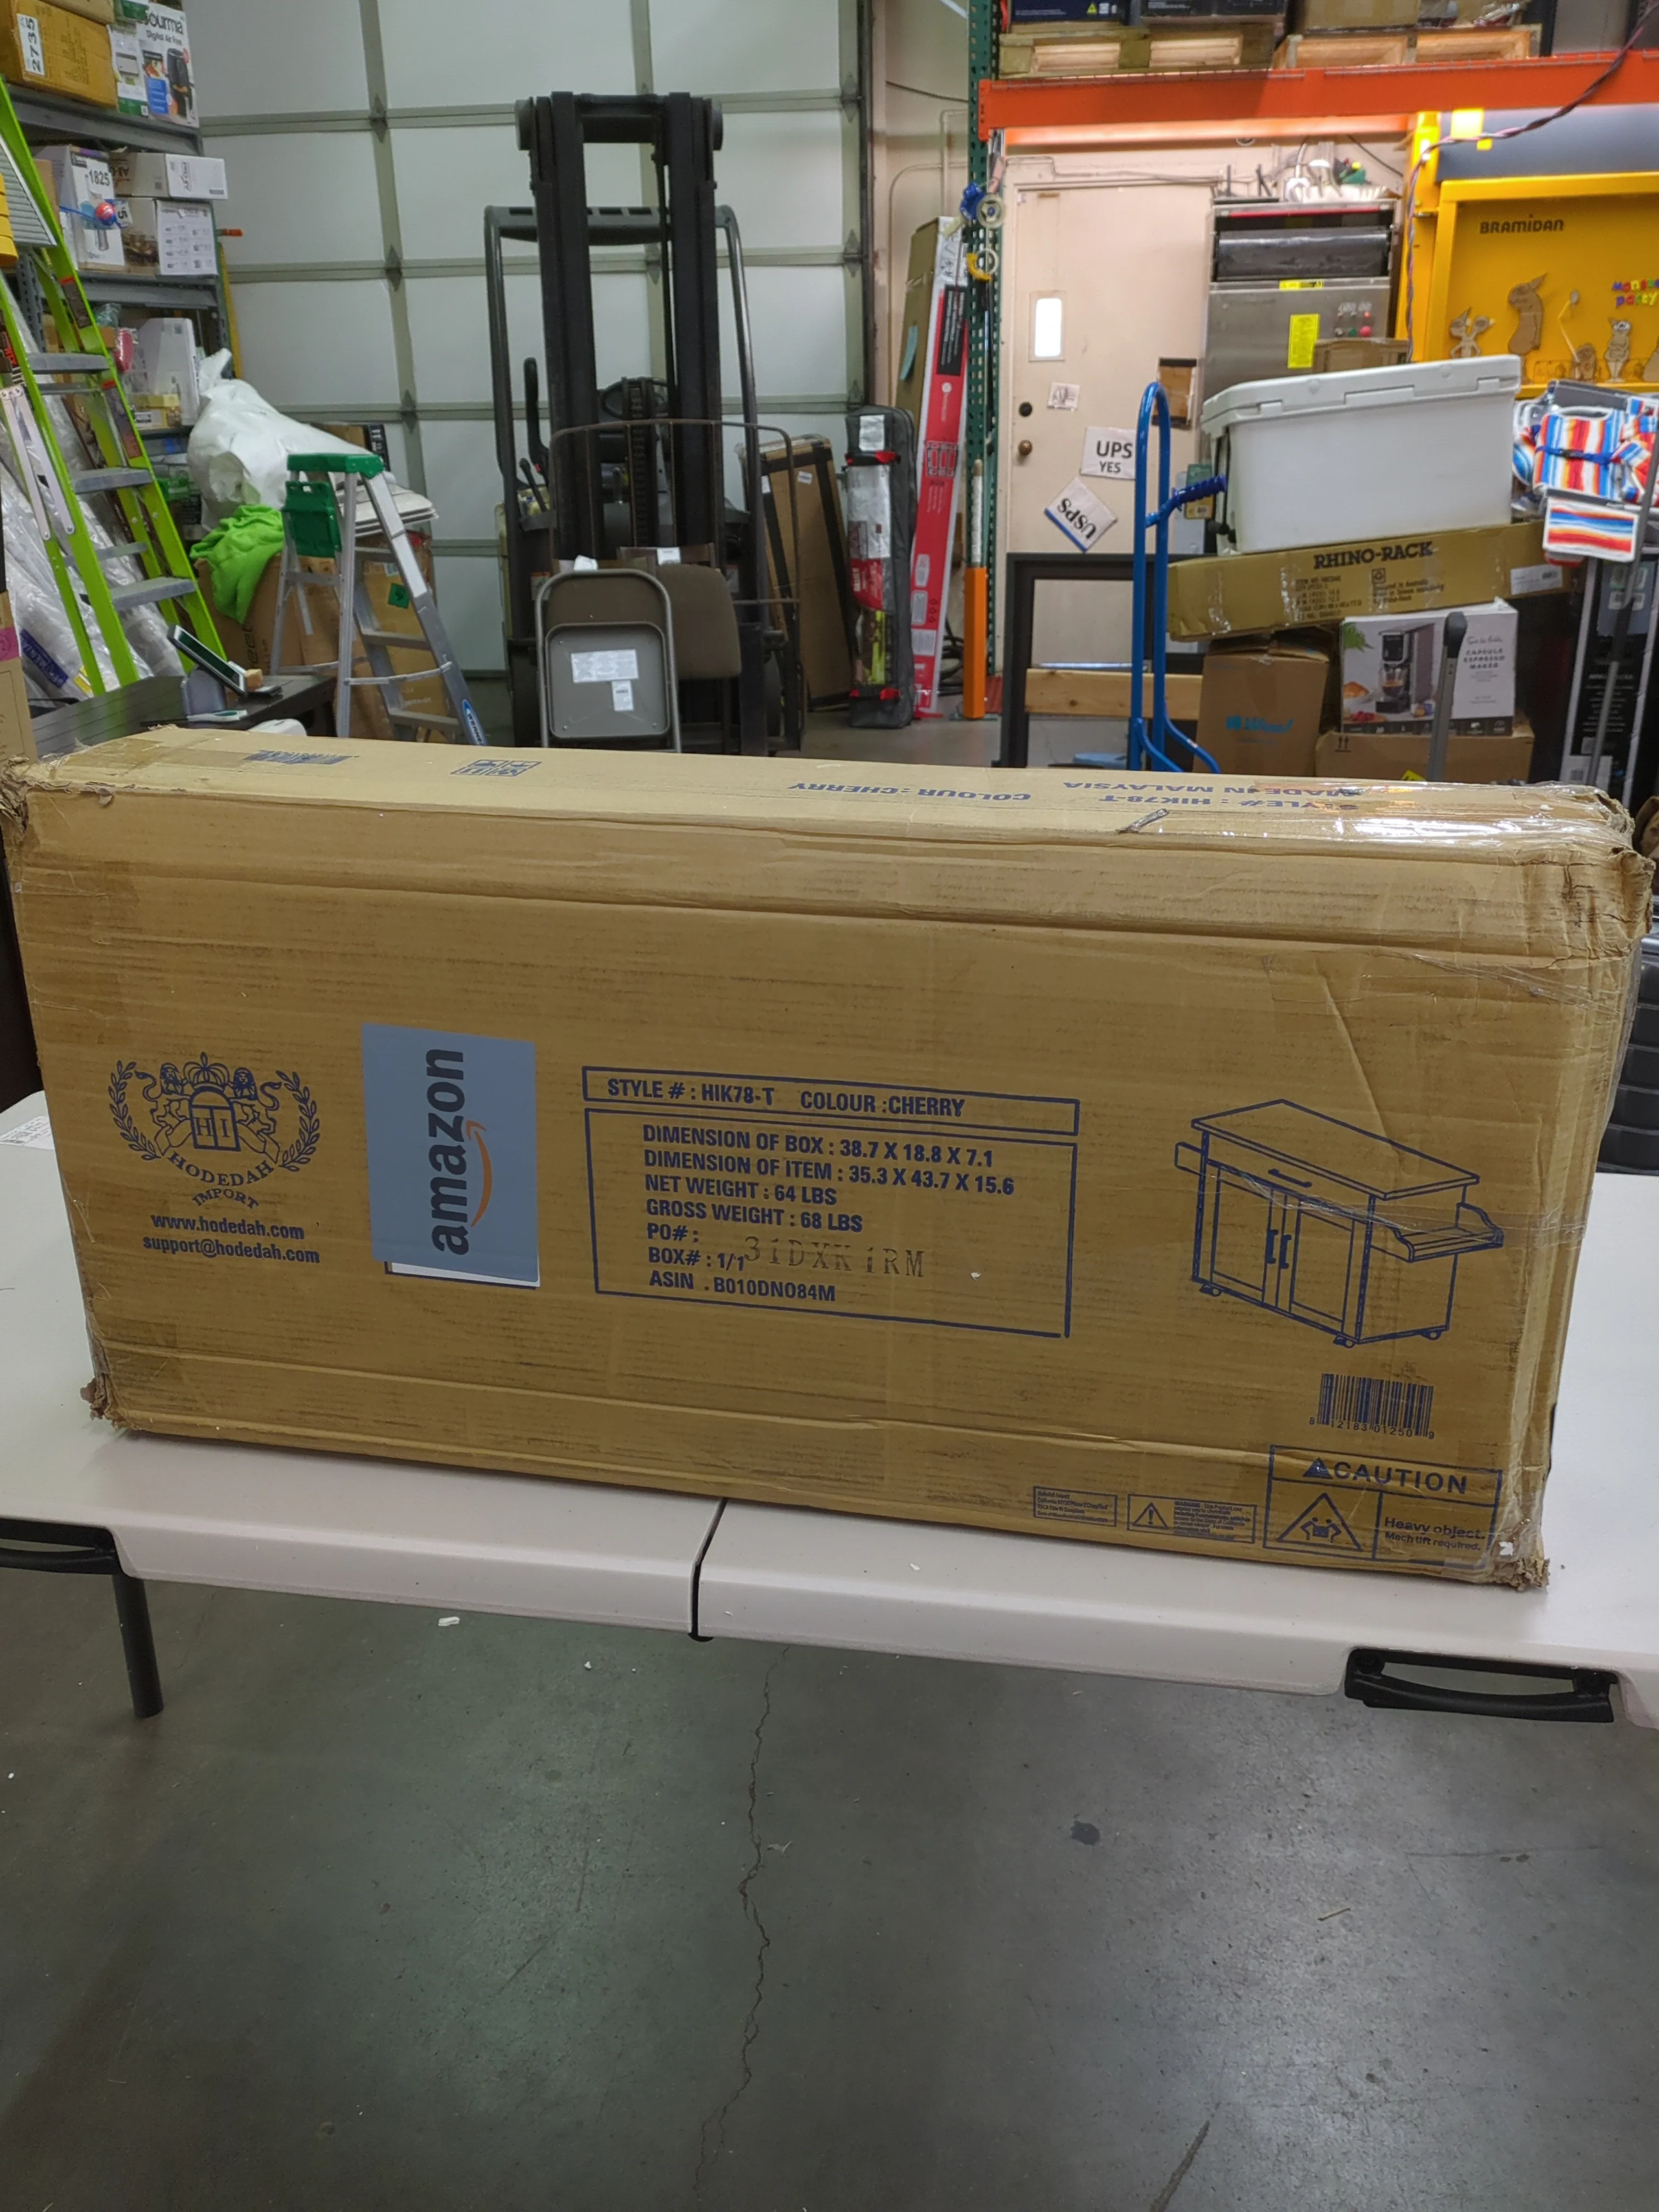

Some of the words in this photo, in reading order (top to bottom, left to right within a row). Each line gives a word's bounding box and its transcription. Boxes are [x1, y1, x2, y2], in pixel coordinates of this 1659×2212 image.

[26, 18, 41, 72] 2735
[1096, 440, 1133, 459] UPS
[1099, 460, 1121, 474] YES
[1057, 497, 1097, 540] USPS
[1313, 540, 1434, 570] RHINO-RACK
[467, 713, 484, 745] WERNE
[788, 782, 899, 795] CHERRY
[918, 788, 1031, 801] COLOUR
[1063, 782, 1214, 793] MALAYSIA
[607, 1078, 663, 1099] STYLE
[701, 1083, 775, 1106] HIK78-T
[800, 1091, 876, 1113] COLOUR
[425, 1048, 470, 1256] amazon
[643, 1124, 751, 1149] DIMENSION
[756, 1132, 780, 1150] OF
[840, 1138, 879, 1158] 38.7
[884, 1142, 898, 1160] X
[903, 1143, 942, 1163] 18.8
[947, 1147, 961, 1165] X
[966, 1148, 992, 1167] 7.1
[168, 1152, 274, 1187] HODEDAH
[644, 1149, 751, 1174] DIMENSION
[756, 1158, 780, 1176] OF
[849, 1165, 888, 1185] 35.3
[892, 1167, 907, 1187] X
[911, 1169, 950, 1189] 43.7
[955, 1173, 969, 1192] X
[975, 1175, 1015, 1196] 15.6
[191, 1188, 259, 1209] IMPORT
[645, 1173, 681, 1193] NET
[774, 1184, 796, 1202] 64
[801, 1186, 837, 1206] LBS
[150, 1215, 305, 1240] www.hodedah.com
[646, 1198, 707, 1220] GROSS
[800, 1211, 822, 1229] 68
[828, 1212, 863, 1232] LBS
[143, 1236, 320, 1263] support@hodedah.com
[1334, 1460, 1468, 1494] CAUTION
[1384, 1516, 1430, 1534] Heavy
[1433, 1525, 1487, 1541] object.
[1384, 1531, 1414, 1544] Mech
